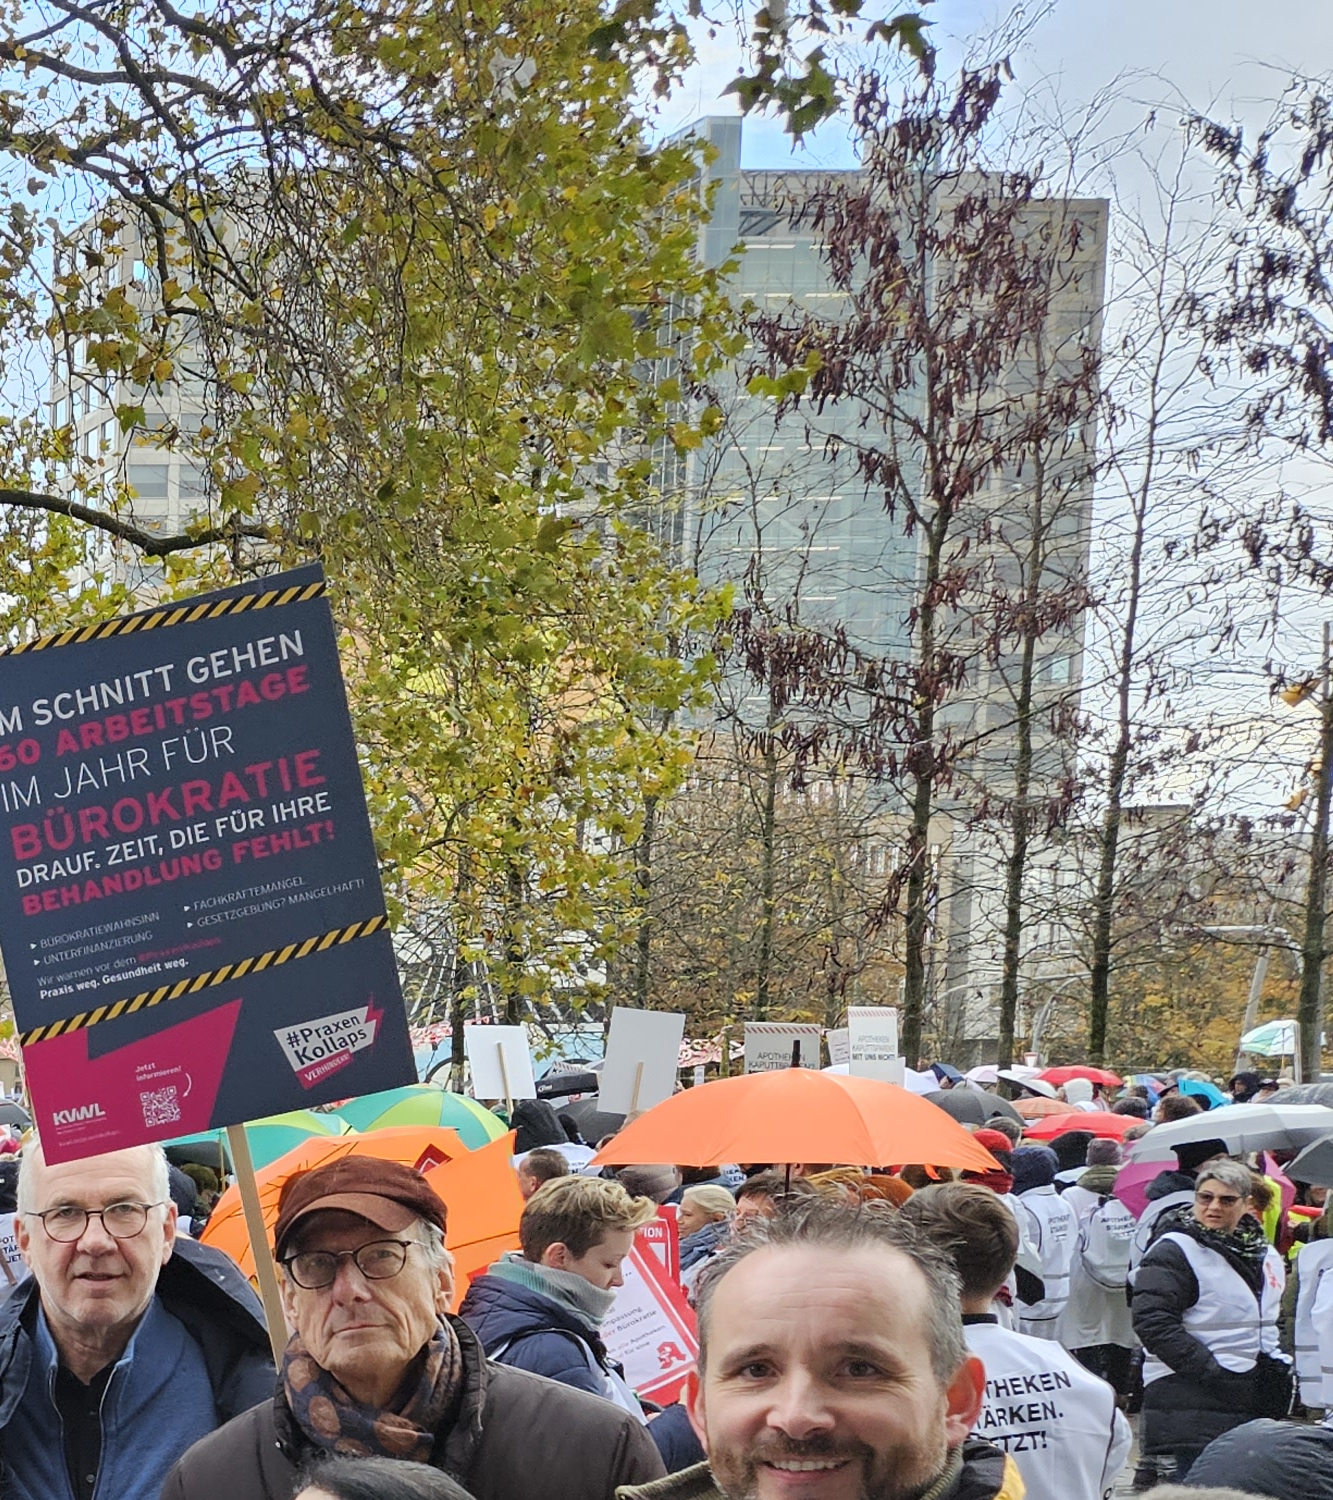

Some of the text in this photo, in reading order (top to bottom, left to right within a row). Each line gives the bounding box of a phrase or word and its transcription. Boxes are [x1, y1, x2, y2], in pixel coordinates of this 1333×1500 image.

[32, 663, 174, 726] SCHNITT
[186, 630, 304, 683] GEHEN
[55, 664, 310, 757] ARBEITSTAGE
[10, 748, 326, 861] BÜROKRATIE
[20, 819, 335, 916] BEHANDLUNG FEHLT!
[285, 1014, 361, 1048] #Praxen
[293, 1027, 367, 1066] Kollaps
[52, 1103, 106, 1126] KVWL
